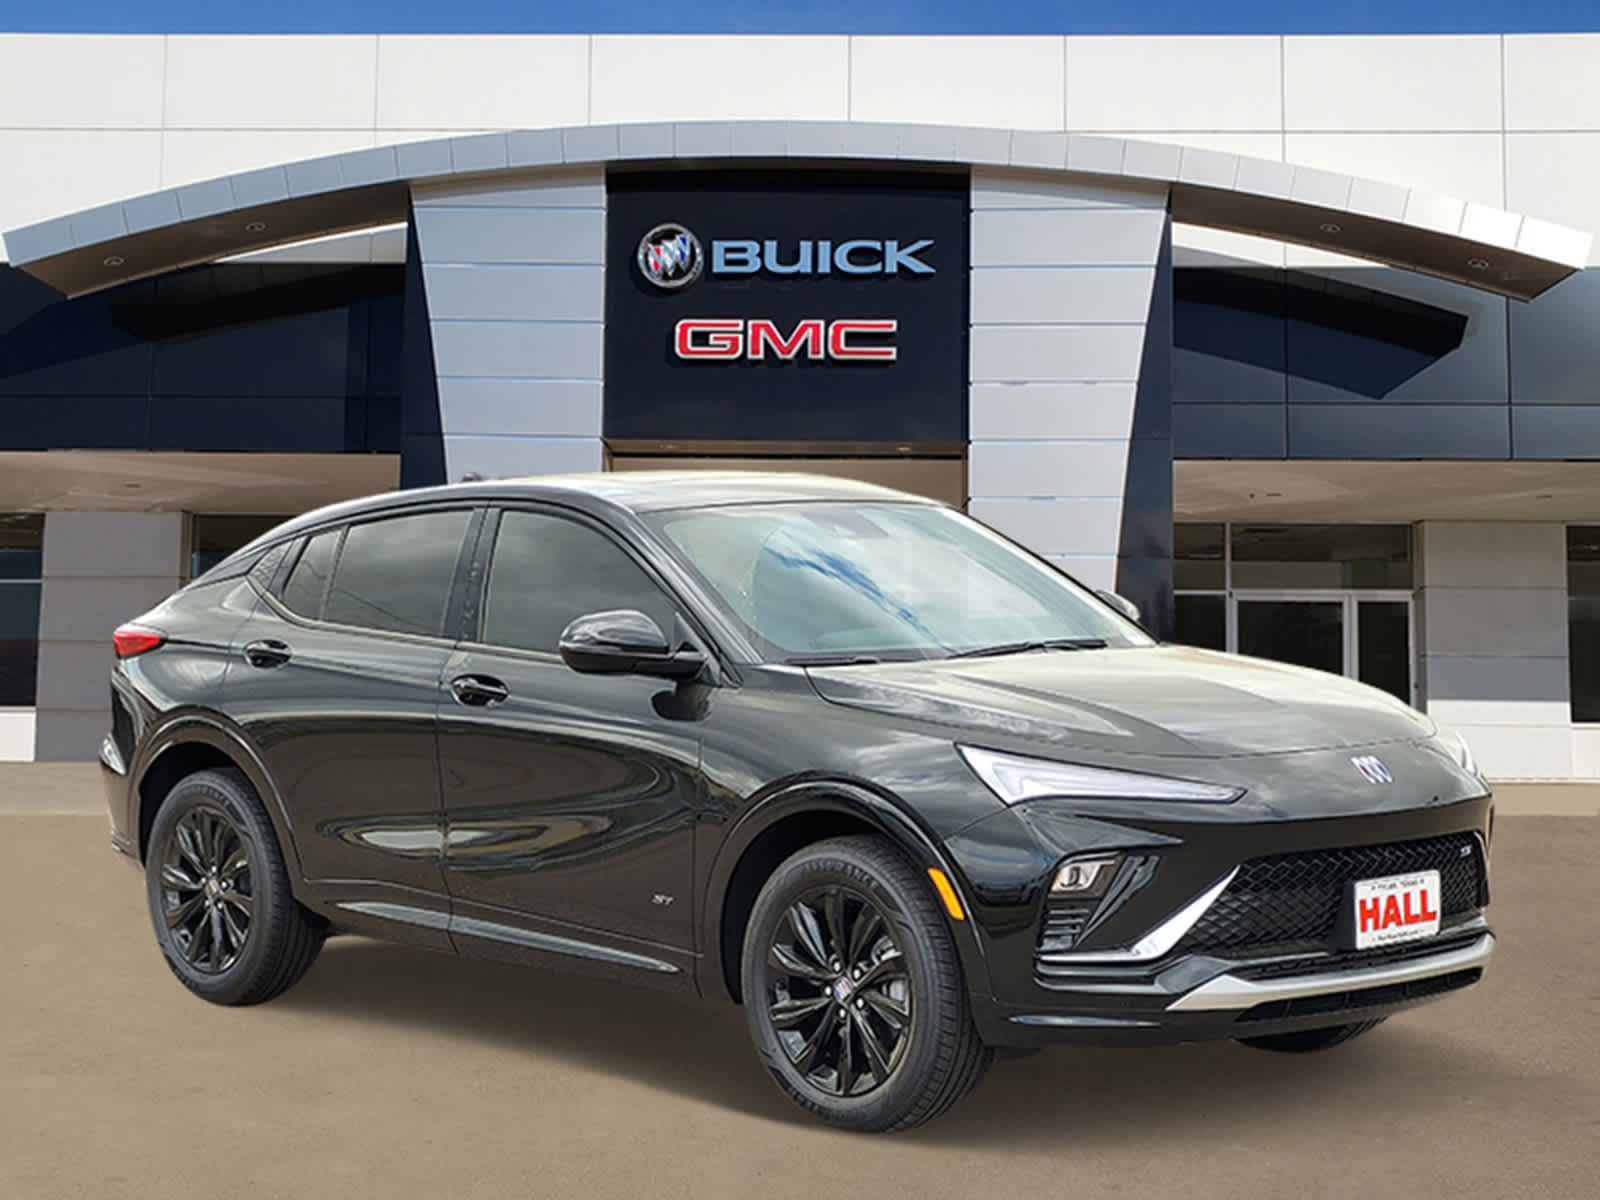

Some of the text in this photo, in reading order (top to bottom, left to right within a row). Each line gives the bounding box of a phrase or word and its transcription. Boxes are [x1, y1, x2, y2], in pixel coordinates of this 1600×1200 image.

[711, 239, 936, 274] BUICK
[674, 318, 898, 361] GMC
[1359, 889, 1437, 933] HALL
